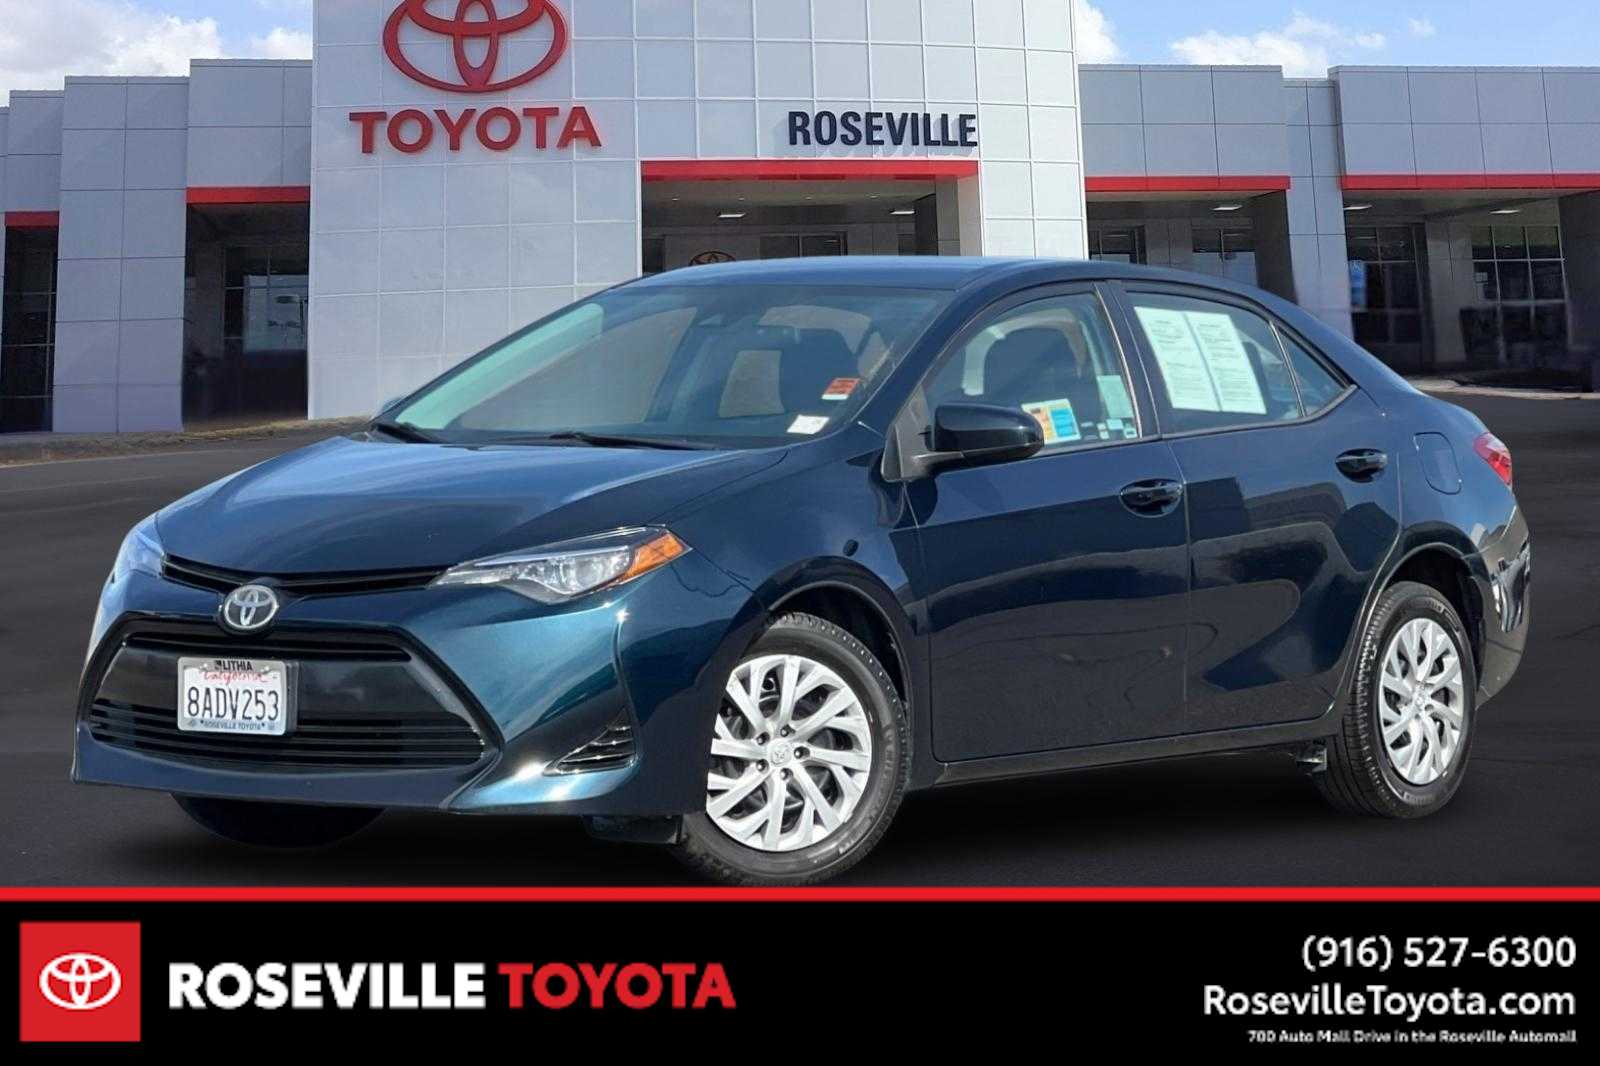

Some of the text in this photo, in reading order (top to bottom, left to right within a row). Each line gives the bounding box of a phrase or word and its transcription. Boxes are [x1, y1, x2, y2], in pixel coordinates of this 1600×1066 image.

[350, 106, 602, 154] TOYOTA
[788, 111, 978, 147] ROSEVILLE
[222, 660, 253, 671] LITHIA
[187, 686, 279, 721] 8ADV253
[204, 720, 262, 731] ROSEVILLE TOYOTA
